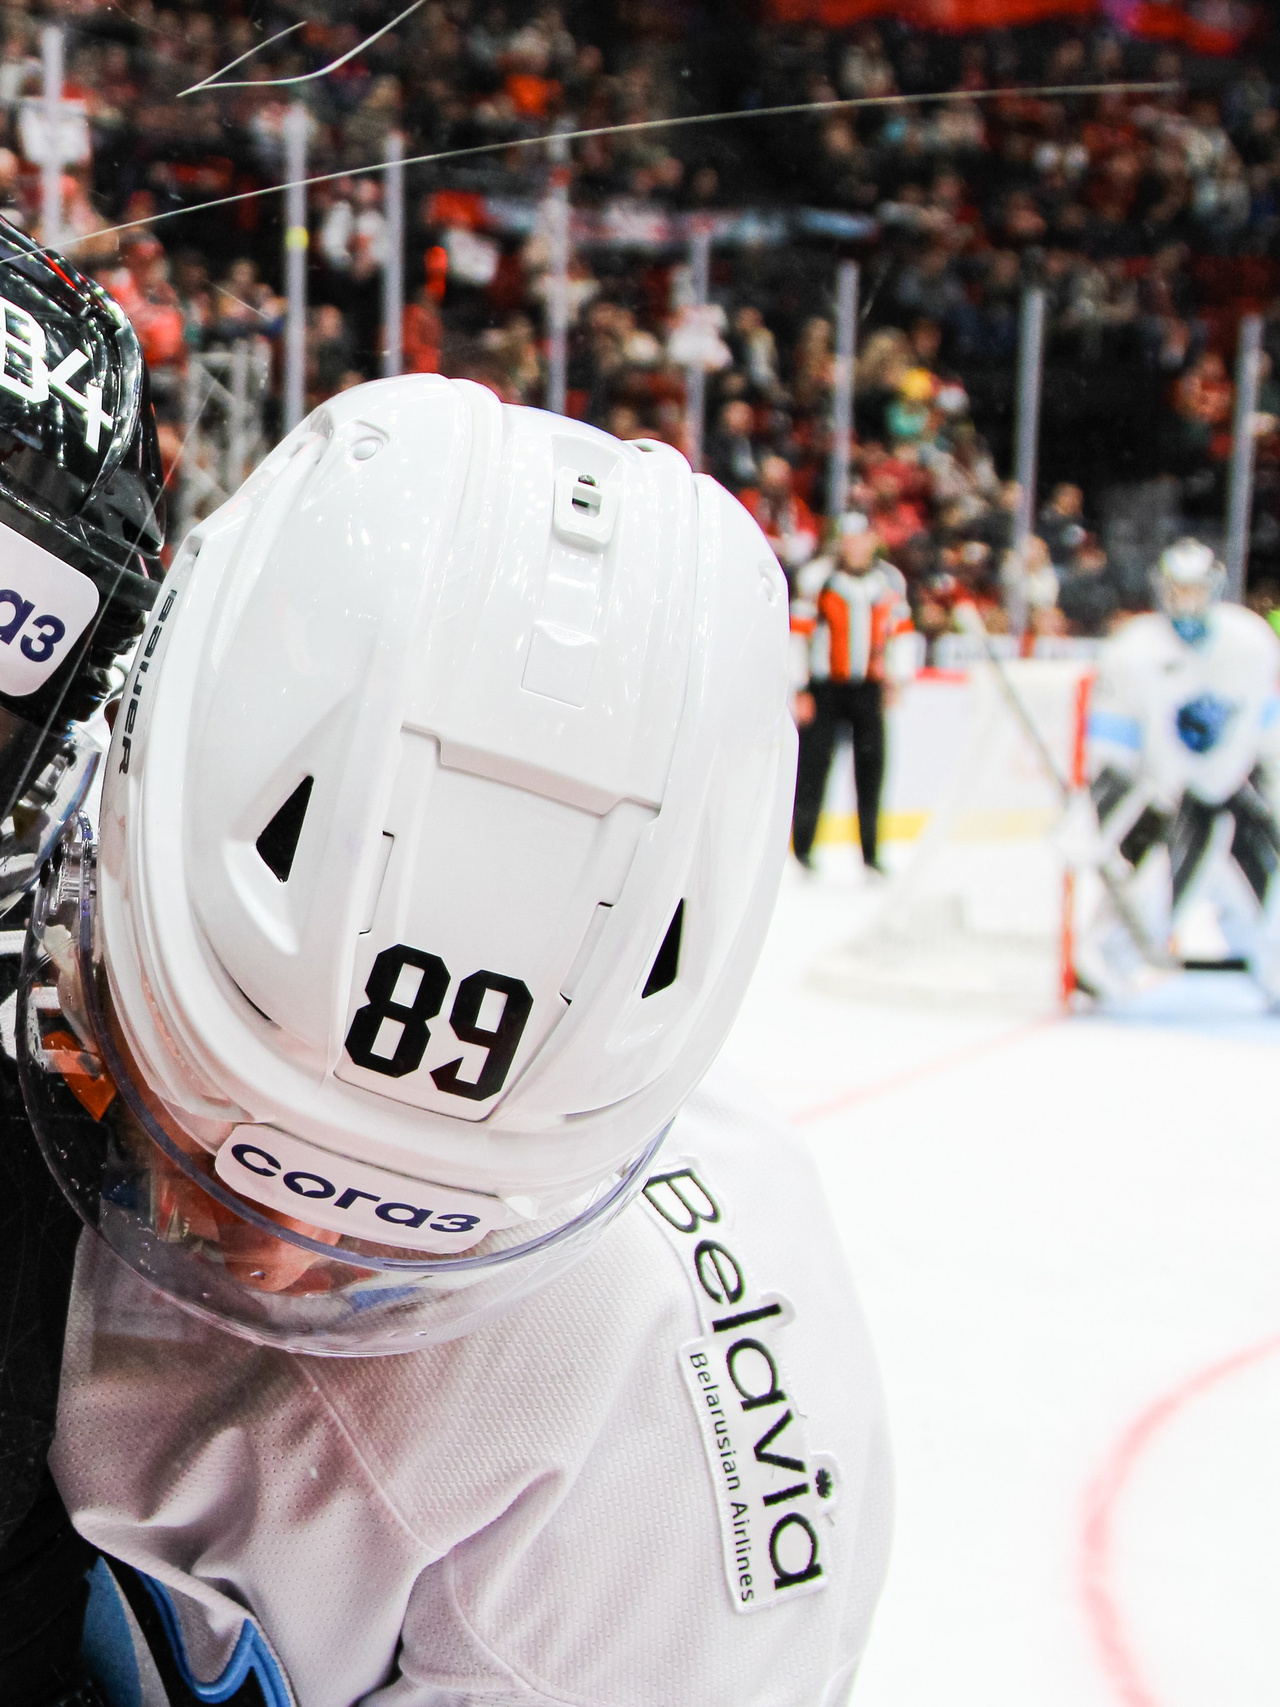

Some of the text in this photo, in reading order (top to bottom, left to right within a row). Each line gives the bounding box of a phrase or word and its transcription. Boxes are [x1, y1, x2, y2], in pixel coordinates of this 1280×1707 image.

[119, 589, 178, 775] BAUER
[344, 943, 535, 1102] 89
[642, 1168, 833, 1590] Belavia
[689, 1352, 754, 1603] Belarusian Airlines
